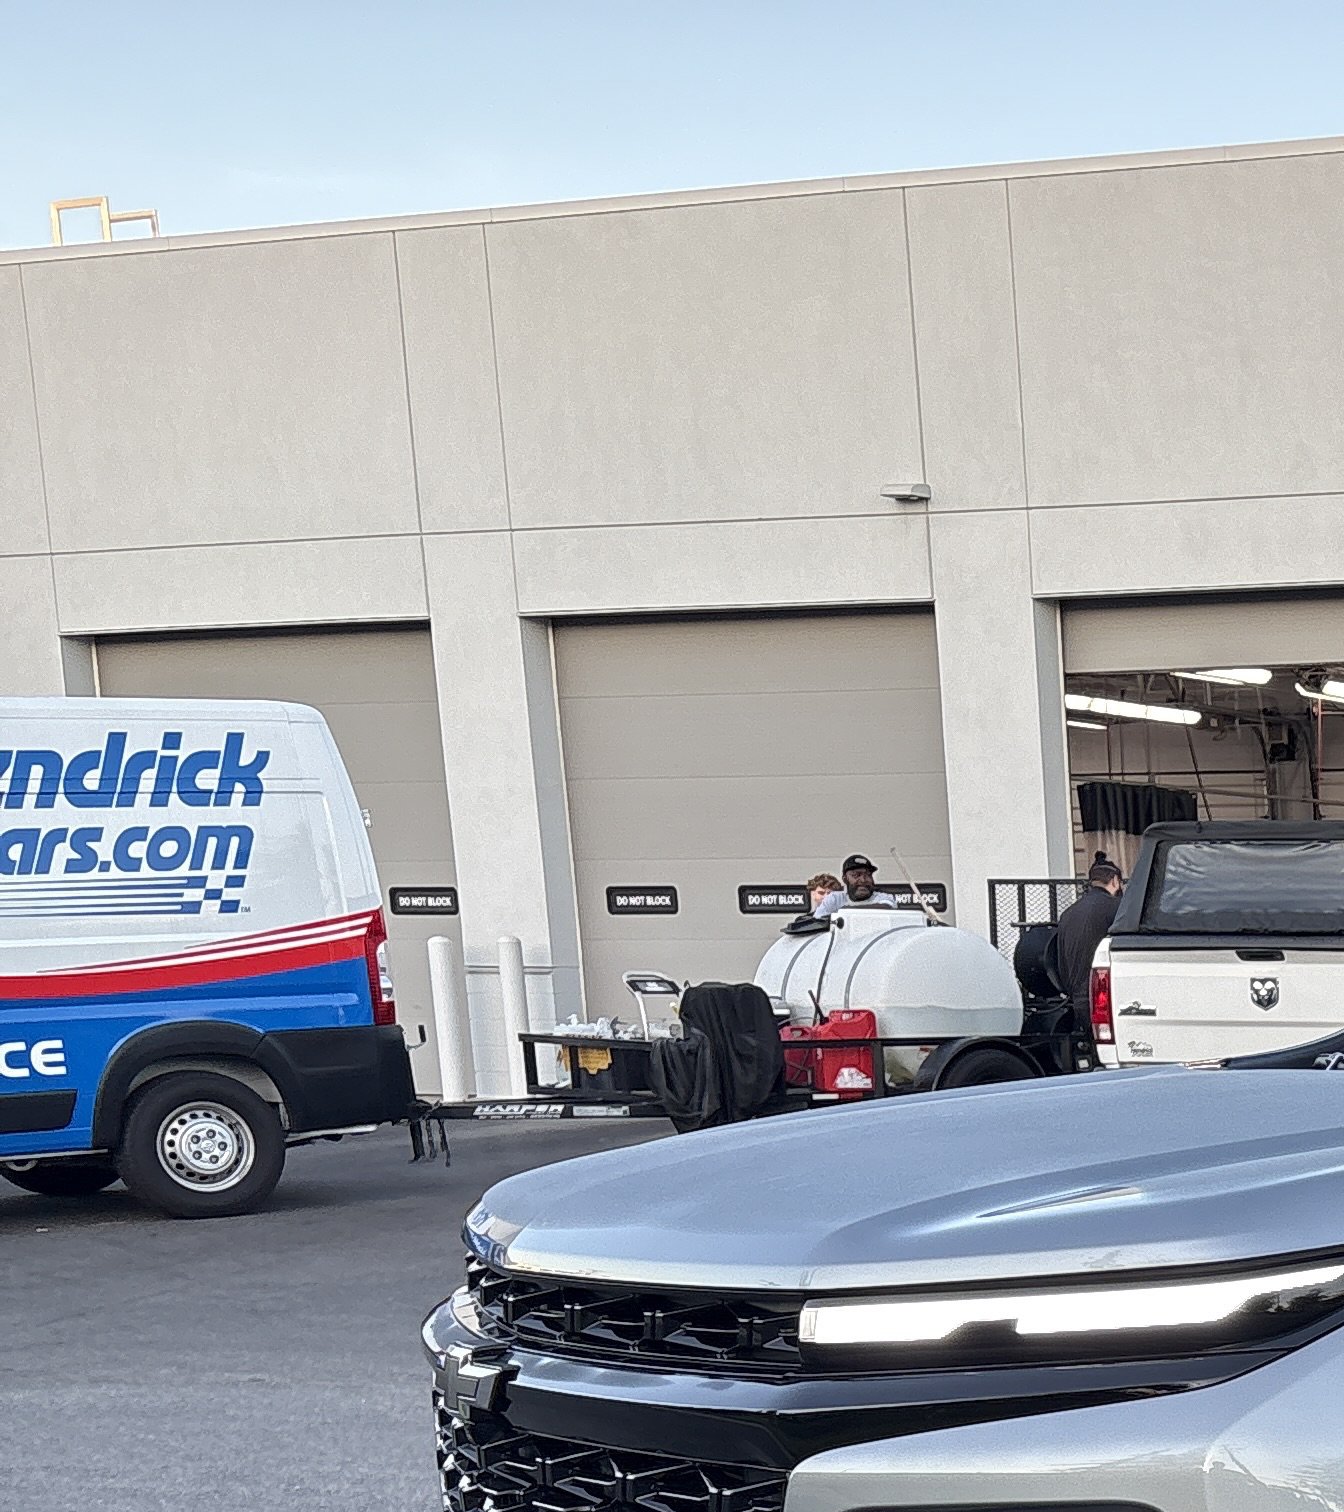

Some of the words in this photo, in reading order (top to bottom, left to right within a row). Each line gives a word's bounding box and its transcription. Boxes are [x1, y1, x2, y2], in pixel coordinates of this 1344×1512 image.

[0, 732, 270, 809] ndrick
[399, 896, 410, 906] DO
[411, 896, 426, 906] NOT
[427, 896, 452, 906] BLOCK
[616, 895, 628, 906] DO
[629, 895, 645, 905] NOT
[646, 895, 671, 905] BLOCK
[748, 895, 760, 905] DO
[761, 895, 777, 905] NOT
[779, 895, 804, 905] BLOCK
